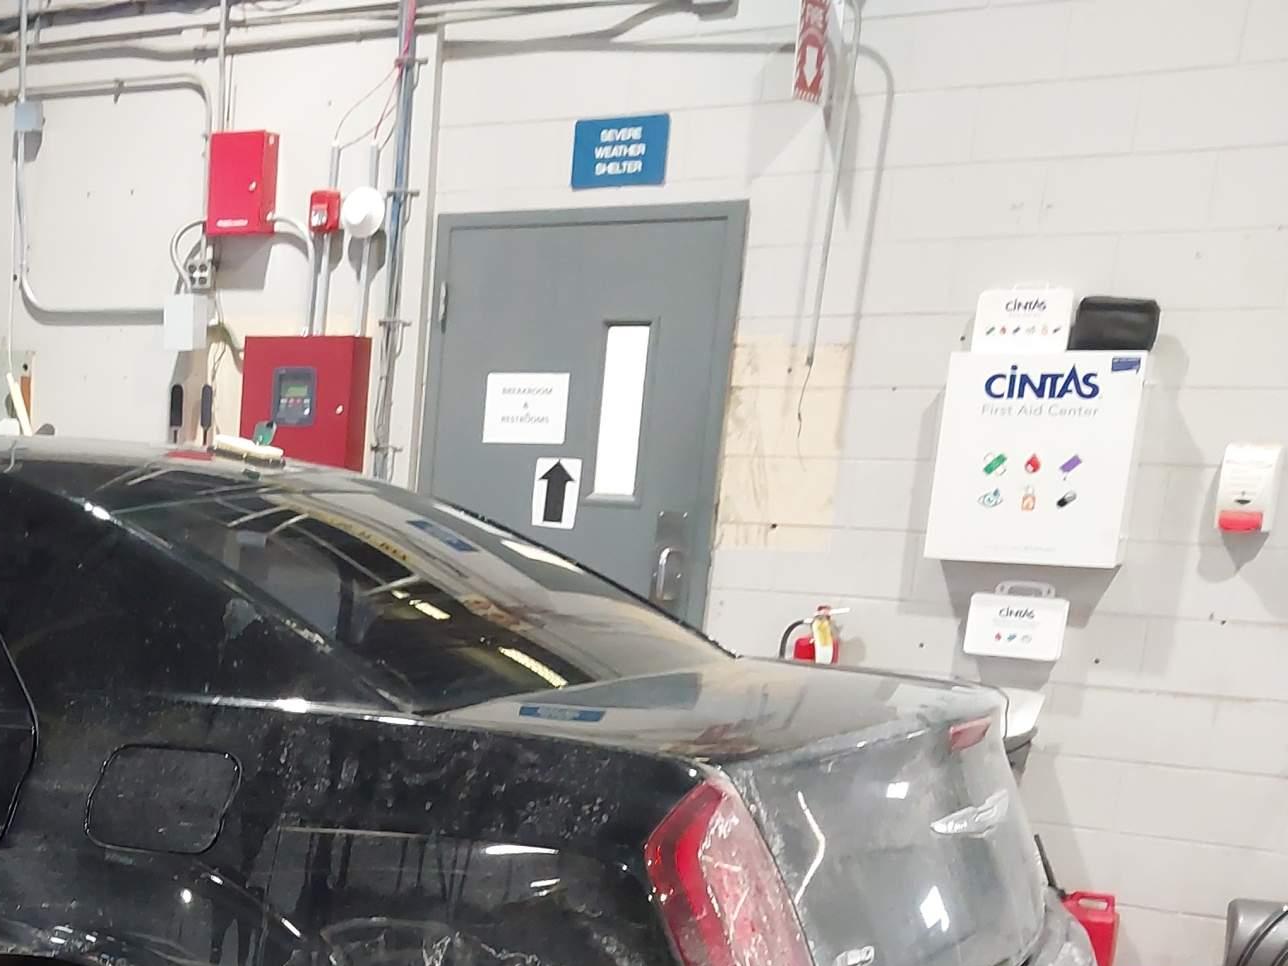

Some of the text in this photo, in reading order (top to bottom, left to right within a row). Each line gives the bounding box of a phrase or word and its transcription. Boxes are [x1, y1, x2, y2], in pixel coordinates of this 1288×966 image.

[805, 3, 827, 28] FIRE
[599, 126, 642, 142] SEVERE
[594, 143, 646, 159] WEATHER
[594, 160, 642, 176] SHELTER
[981, 402, 1099, 417] First Aid Center
[500, 415, 549, 424] RESTROOMS
